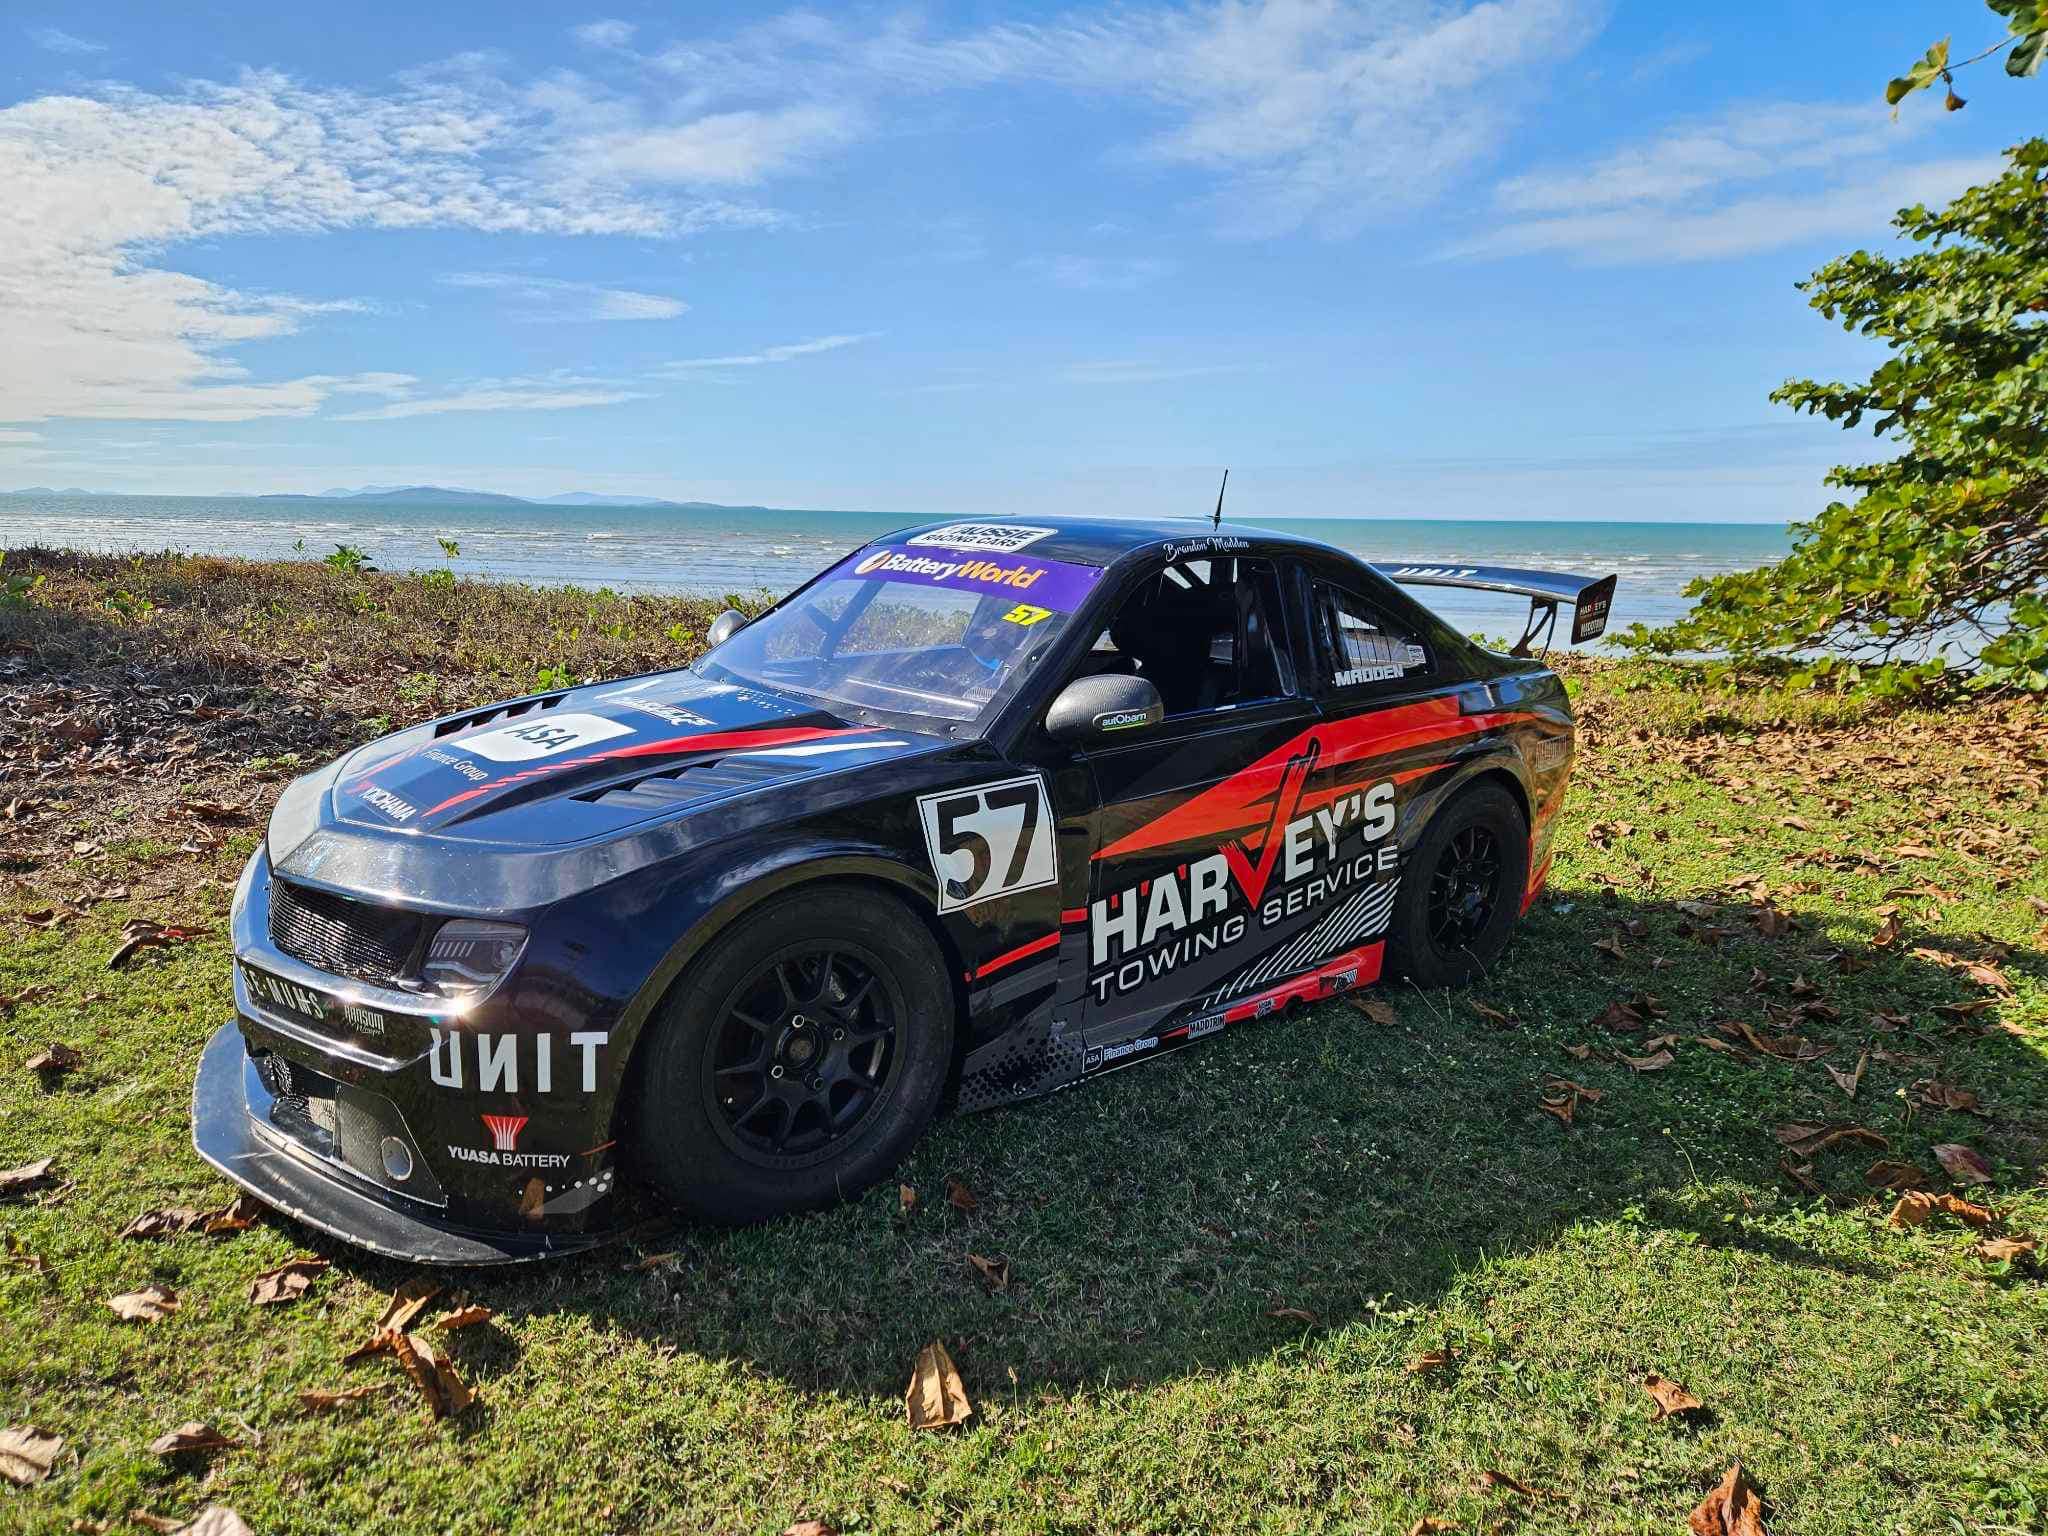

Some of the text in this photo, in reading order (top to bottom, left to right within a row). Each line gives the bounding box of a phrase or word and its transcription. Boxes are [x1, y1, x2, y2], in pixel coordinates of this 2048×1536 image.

[976, 536, 1022, 547] CARS
[1163, 537, 1249, 562] Brandon Madden
[1002, 603, 1053, 626] 57
[1335, 663, 1404, 687] MADDEN
[503, 724, 579, 750] ASA
[452, 759, 488, 781] Group
[936, 783, 1039, 900] 57
[1091, 782, 1396, 966] HARVEY'S
[1091, 845, 1399, 1001] TOWING SERVICE
[430, 1028, 608, 1093] UNIT
[1085, 1053, 1100, 1064] ASA
[1104, 1037, 1159, 1060] Finance Group
[448, 1145, 570, 1168] YUASA BATTERY
